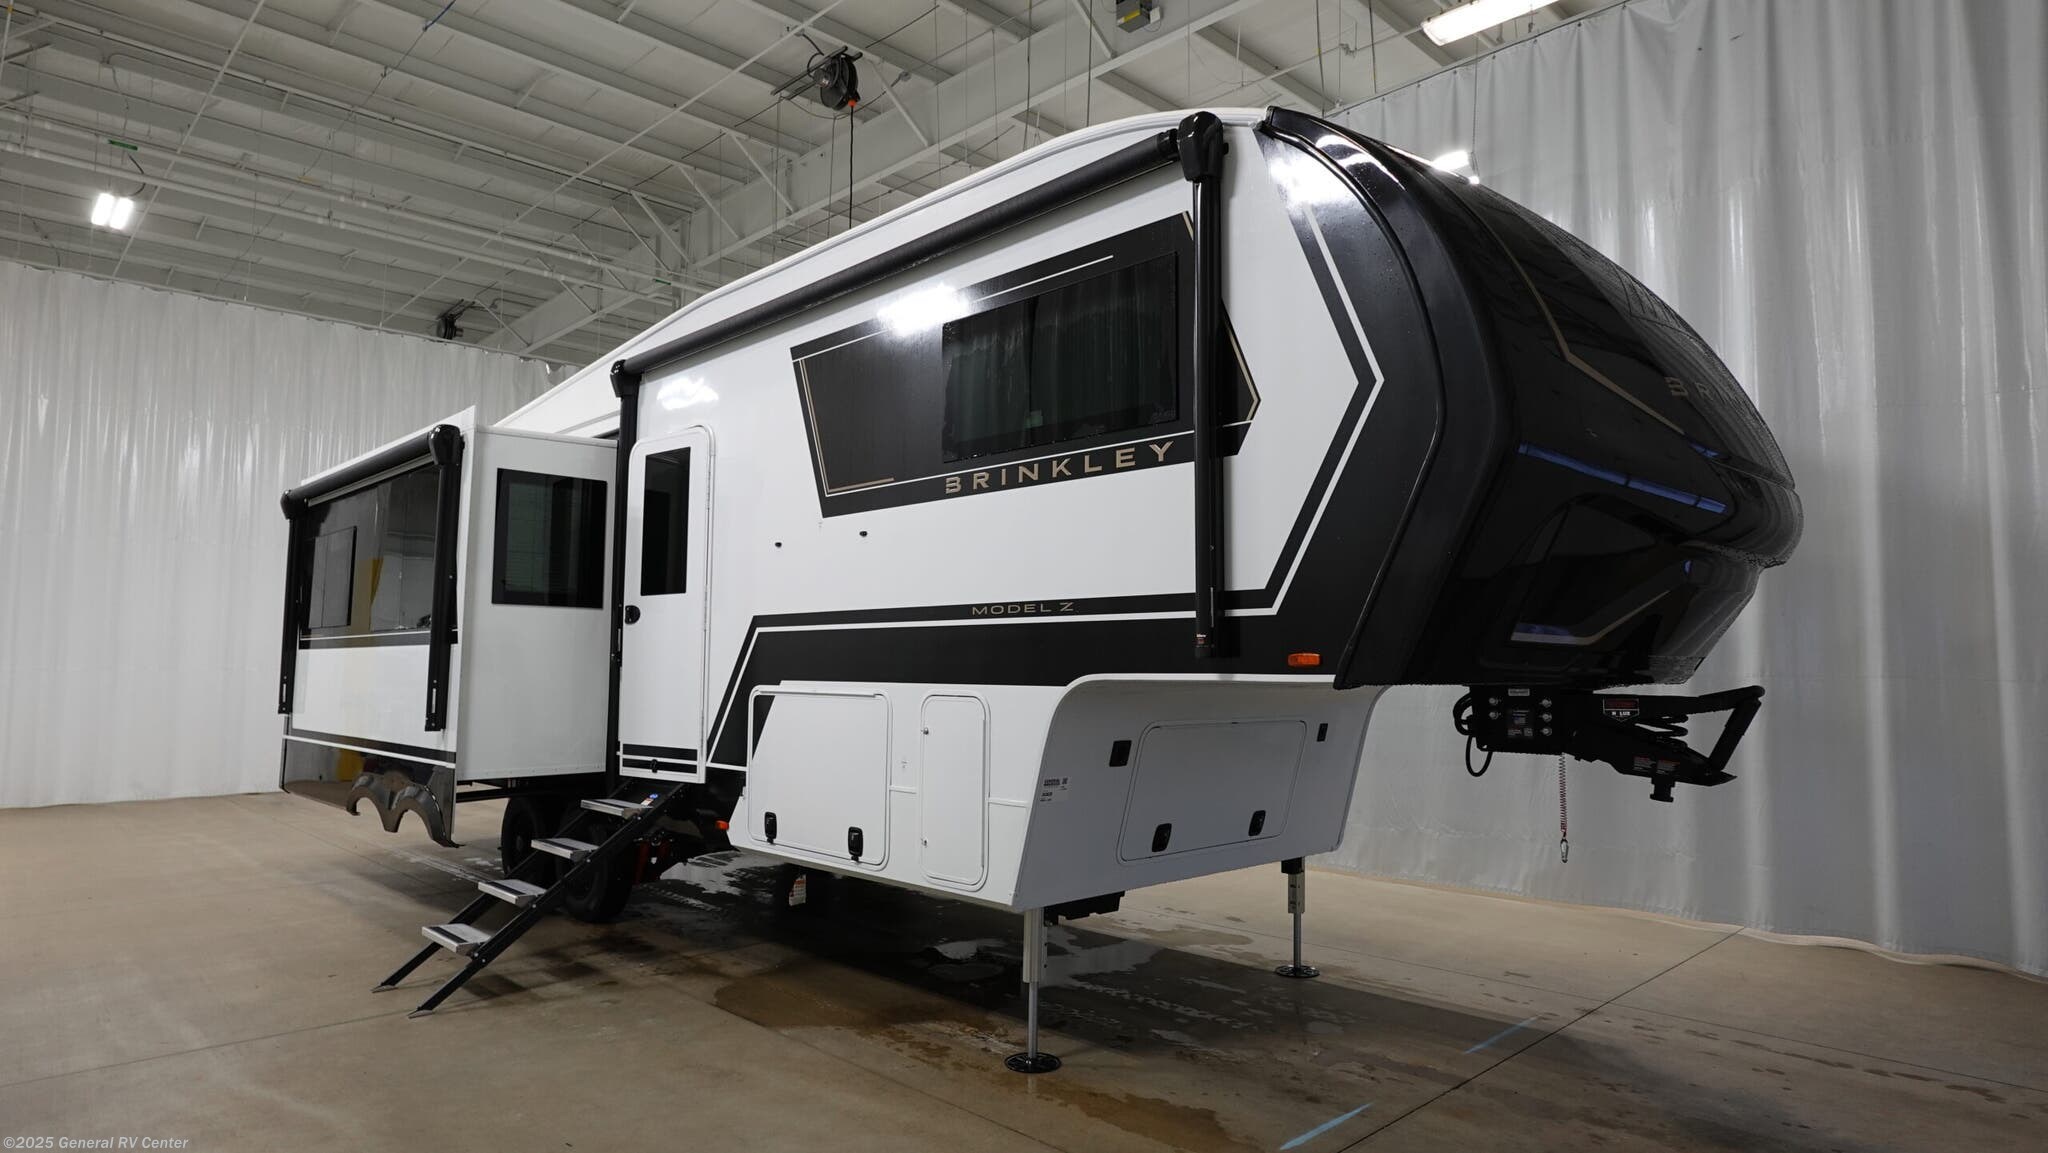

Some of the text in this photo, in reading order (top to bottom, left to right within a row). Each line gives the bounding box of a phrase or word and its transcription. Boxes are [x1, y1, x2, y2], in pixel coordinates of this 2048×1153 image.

[945, 440, 1175, 494] BRINKLEY
[972, 602, 1075, 616] MODEL Z
